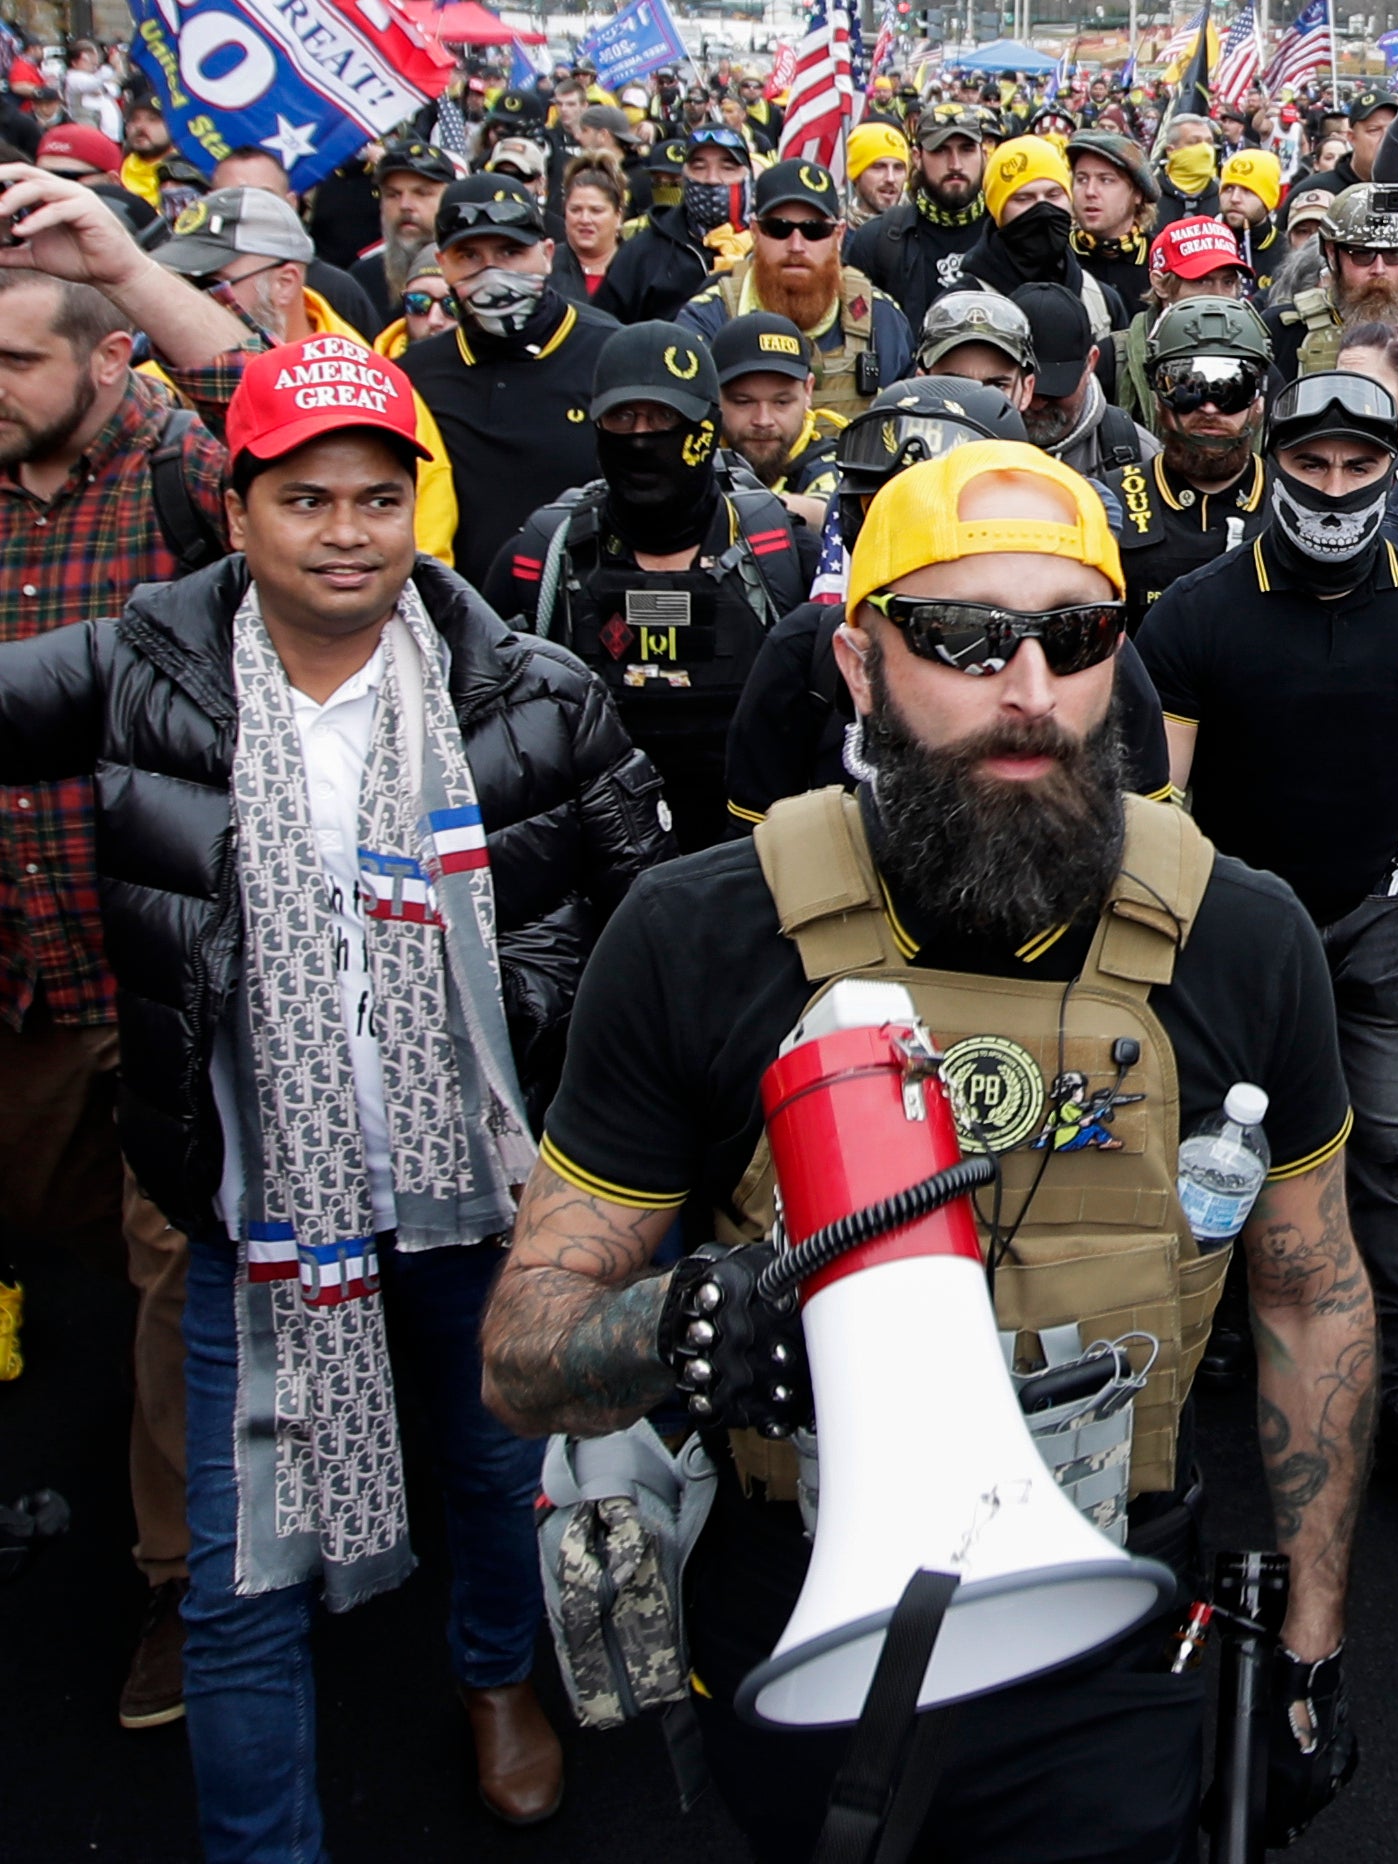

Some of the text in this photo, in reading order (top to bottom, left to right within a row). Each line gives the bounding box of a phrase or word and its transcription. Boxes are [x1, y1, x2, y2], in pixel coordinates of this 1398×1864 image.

[140, 19, 189, 108] United
[188, 115, 232, 160] Sta
[1170, 224, 1201, 243] MAKE
[1179, 238, 1214, 256] GREAT
[302, 337, 370, 364] KEEP
[274, 361, 398, 397] AMERICA
[295, 385, 388, 413] GREAT
[969, 1074, 1000, 1105] PB
